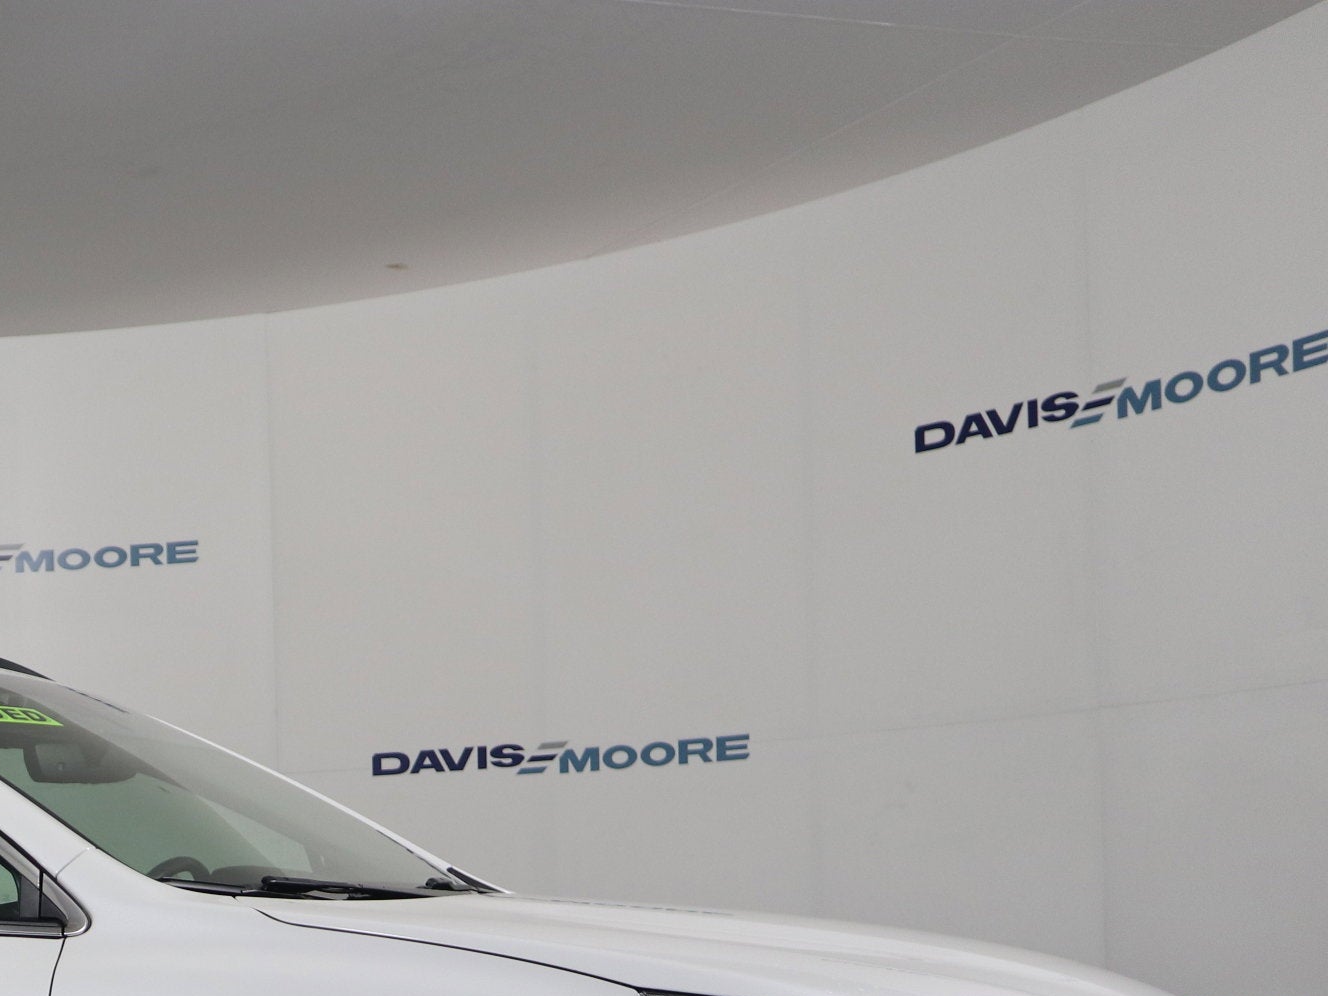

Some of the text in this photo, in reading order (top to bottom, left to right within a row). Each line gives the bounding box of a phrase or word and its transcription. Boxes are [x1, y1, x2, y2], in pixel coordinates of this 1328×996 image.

[914, 328, 1328, 454] DAVIS MOORE
[15, 540, 199, 573] MOORE
[372, 733, 750, 776] DAVIS MOORE
